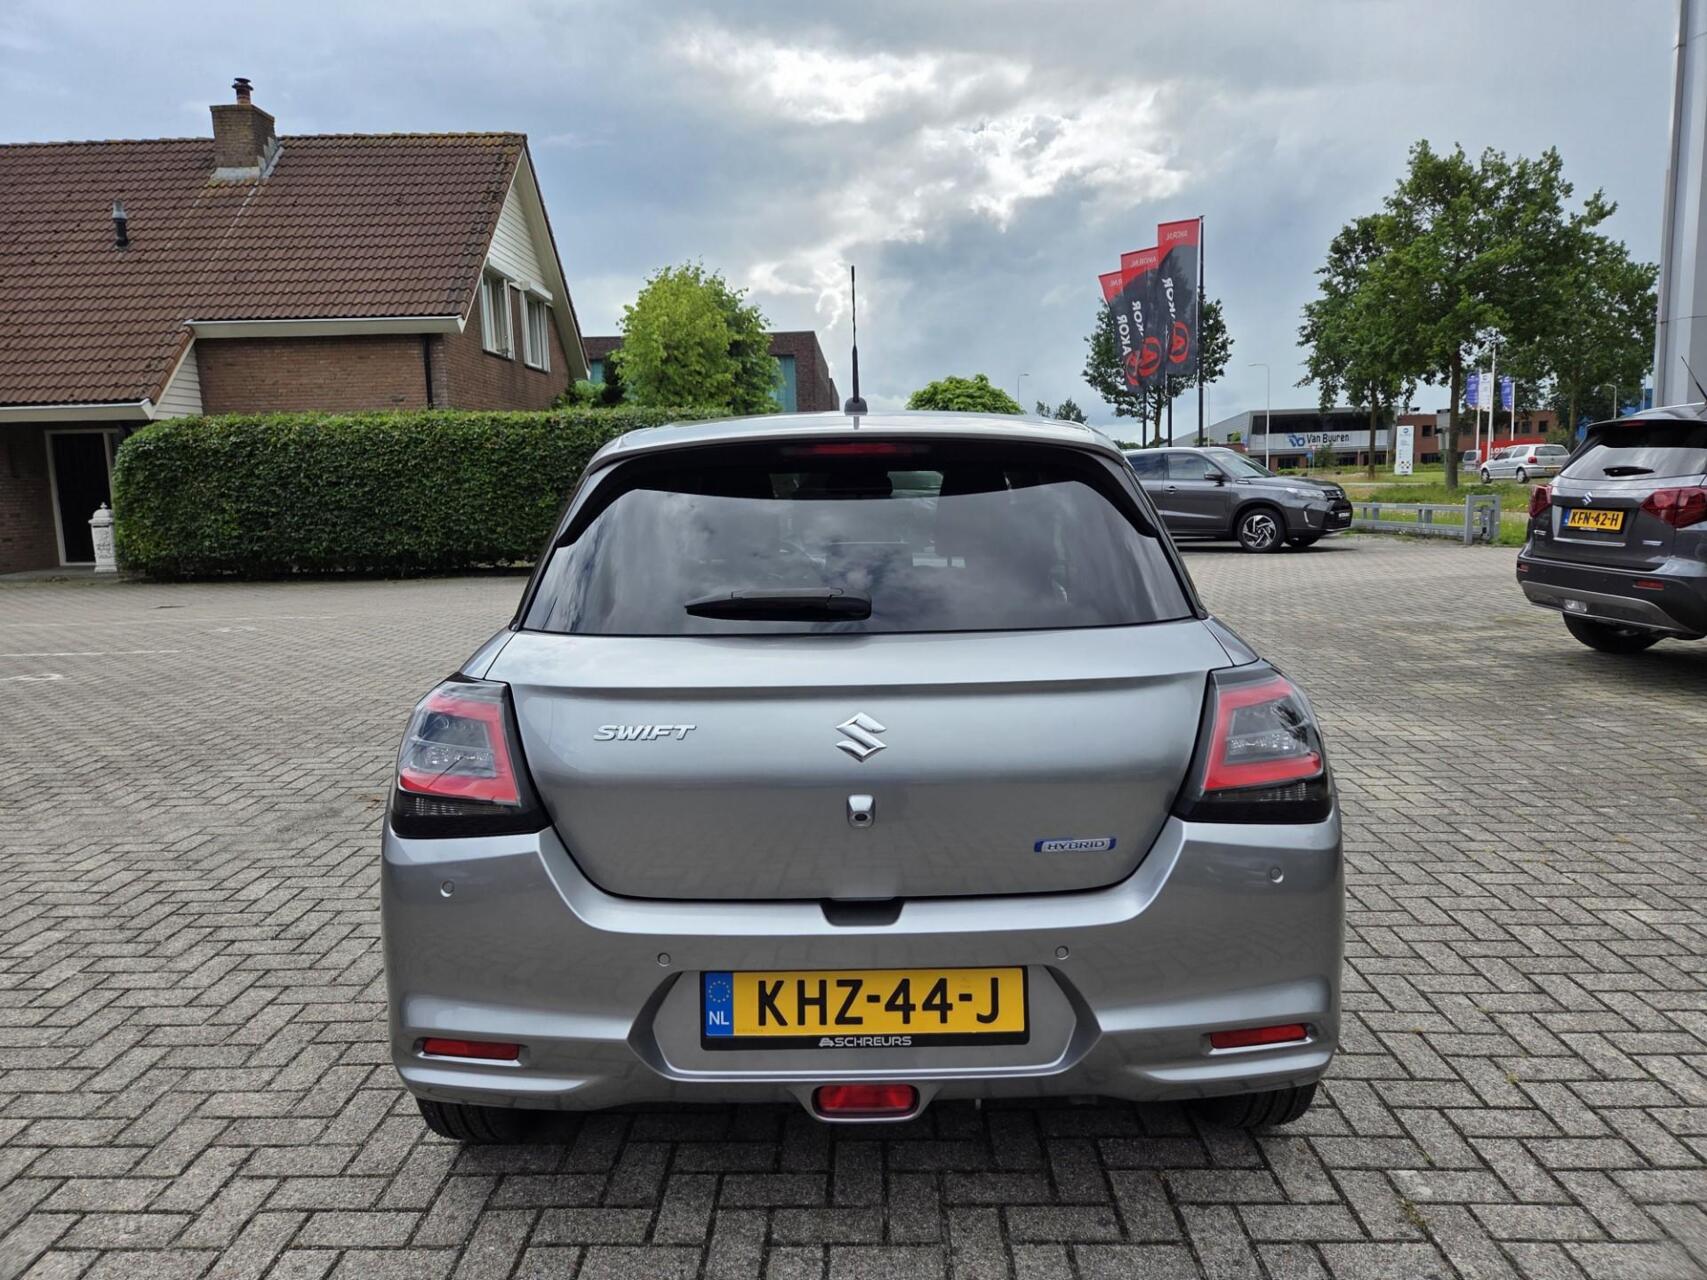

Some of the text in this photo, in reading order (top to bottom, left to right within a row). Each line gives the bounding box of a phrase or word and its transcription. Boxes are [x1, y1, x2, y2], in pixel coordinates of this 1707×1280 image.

[1306, 433, 1321, 444] Van
[1570, 511, 1619, 527] KFN-42-H
[593, 724, 697, 741] SWIFT
[1047, 840, 1105, 850] HYBRID
[708, 977, 1000, 1027] NL KHZ-44-J
[834, 1036, 912, 1047] SCHREURS
